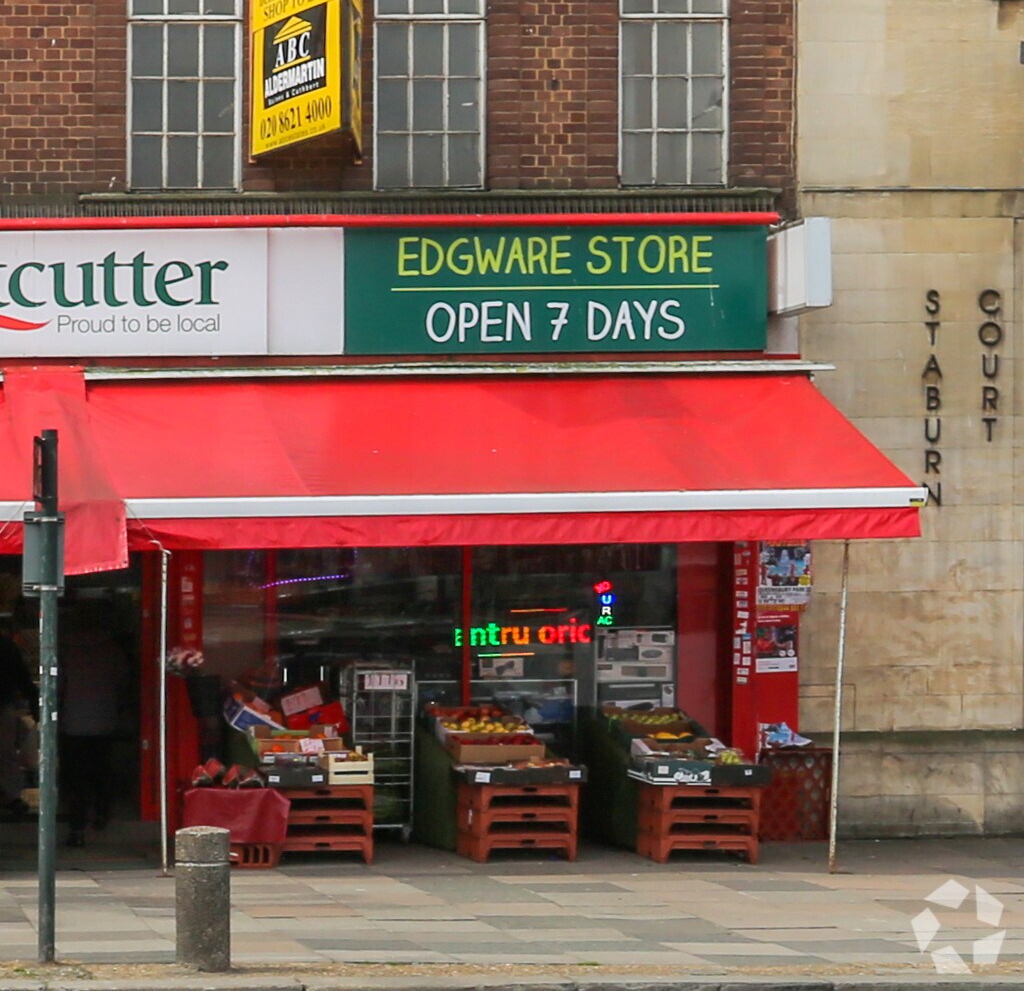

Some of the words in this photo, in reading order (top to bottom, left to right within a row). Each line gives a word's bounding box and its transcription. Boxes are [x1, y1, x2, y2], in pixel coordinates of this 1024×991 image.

[274, 31, 311, 68] ABC
[264, 57, 325, 99] ALDERMARTIN
[259, 114, 277, 141] 020
[278, 105, 302, 134] 8621
[305, 95, 332, 124] 4000
[397, 235, 573, 277] EDGWARE
[586, 235, 714, 275] STORE
[57, 314, 116, 333] Proud
[121, 316, 141, 333] to
[146, 314, 172, 333] be
[177, 313, 221, 333] local
[425, 300, 532, 344] OPEN
[547, 302, 570, 341] 7
[587, 299, 686, 342] DAYS
[978, 289, 1002, 443] COURT
[922, 289, 942, 507] STABURN
